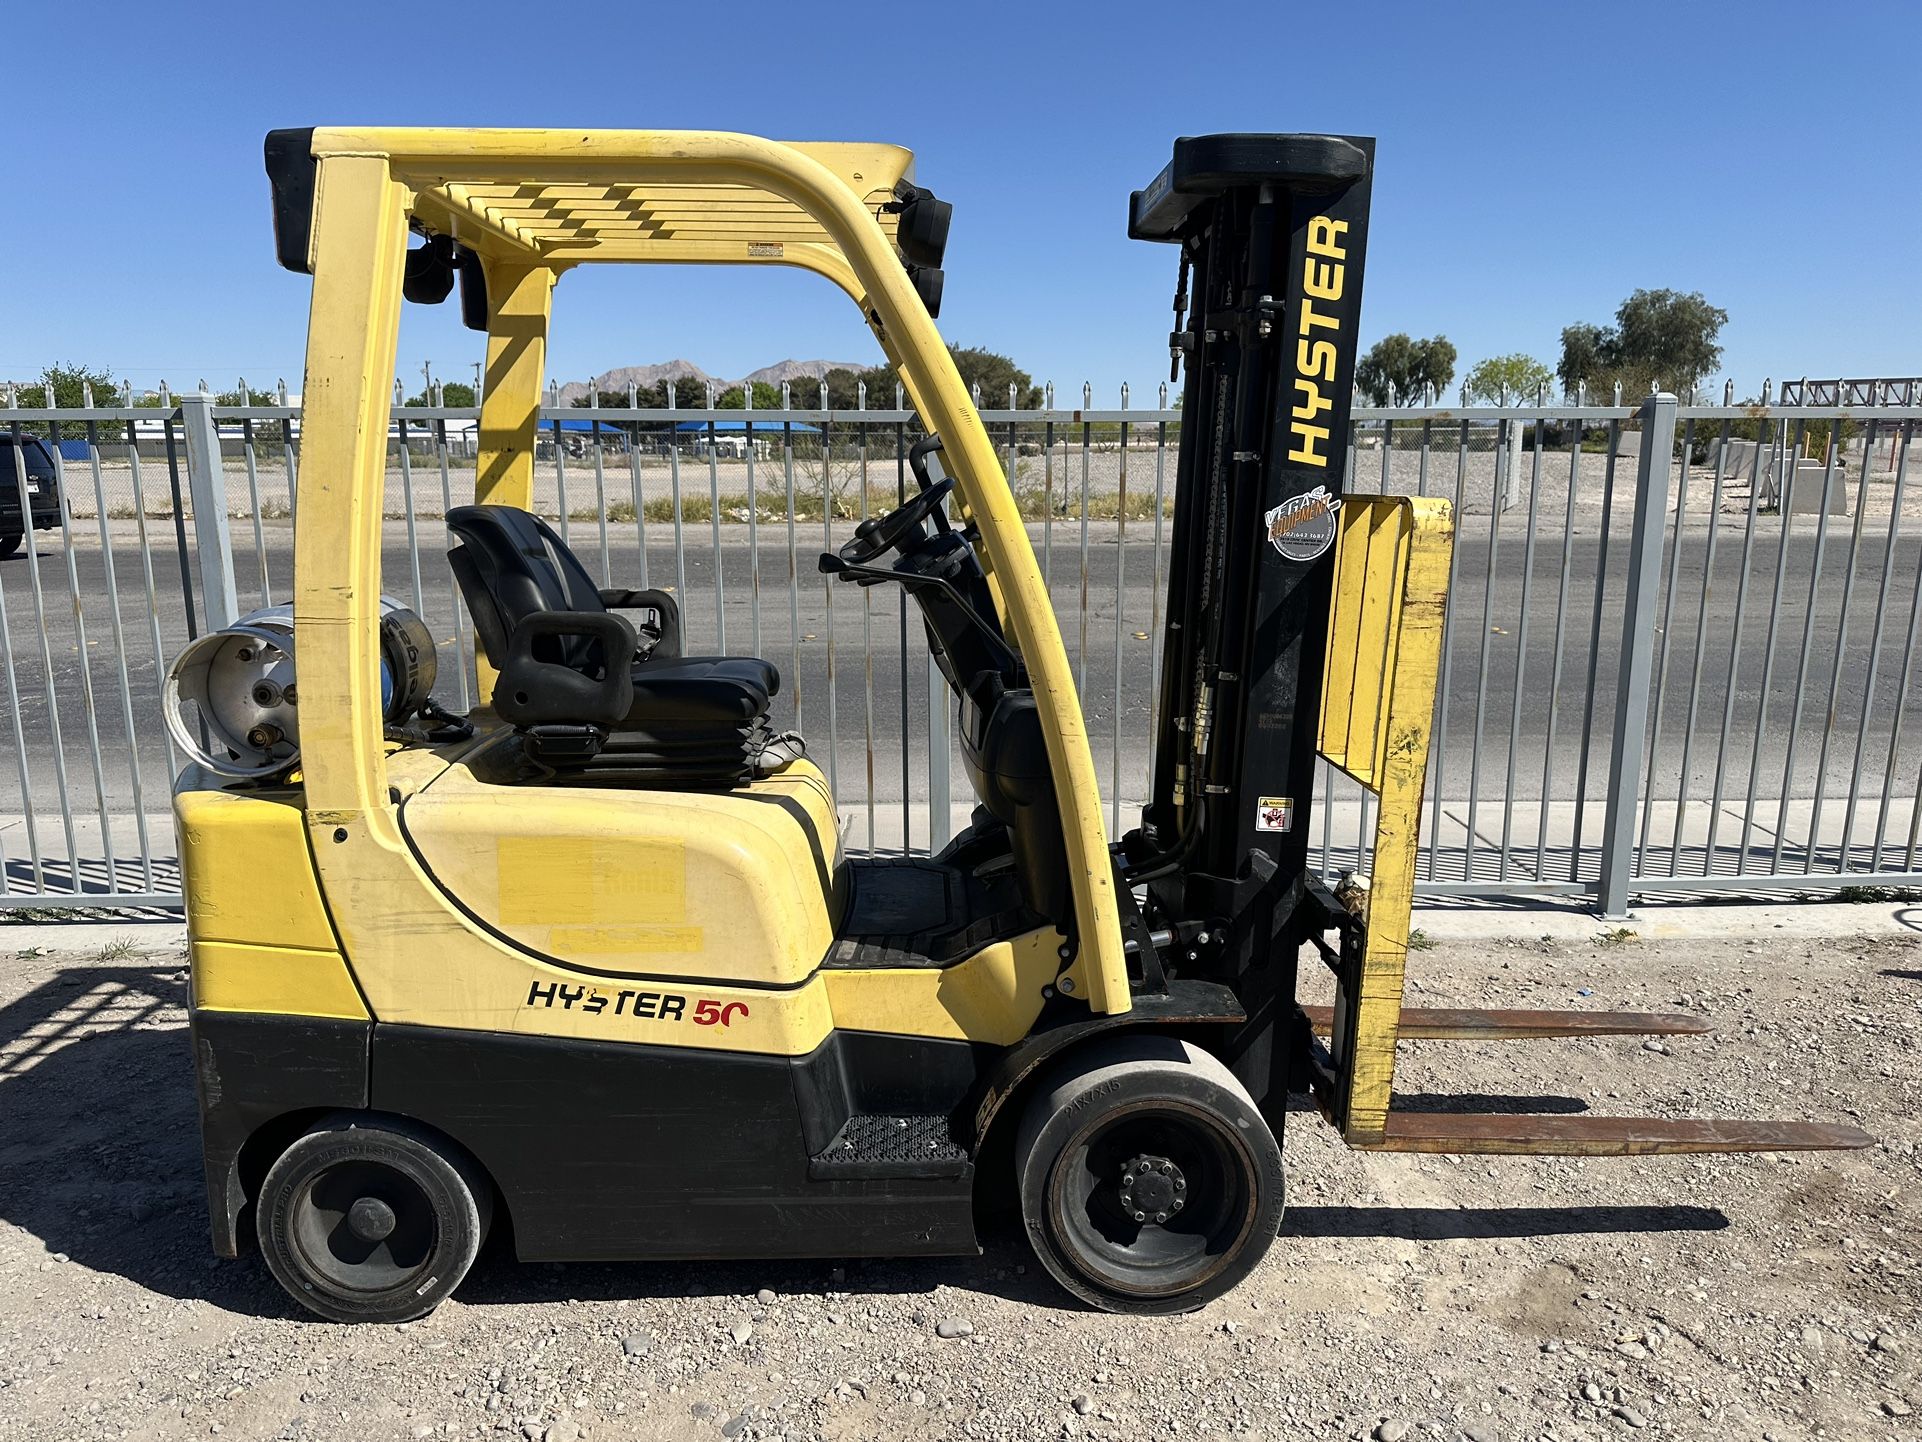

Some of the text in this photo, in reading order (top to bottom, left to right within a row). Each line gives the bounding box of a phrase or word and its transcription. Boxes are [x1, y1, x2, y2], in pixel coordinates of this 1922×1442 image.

[1288, 215, 1349, 467] HYSTER
[1265, 486, 1324, 525] VEGAS
[1269, 494, 1331, 538] EQUIPMENT
[527, 981, 686, 1021] HYSTER
